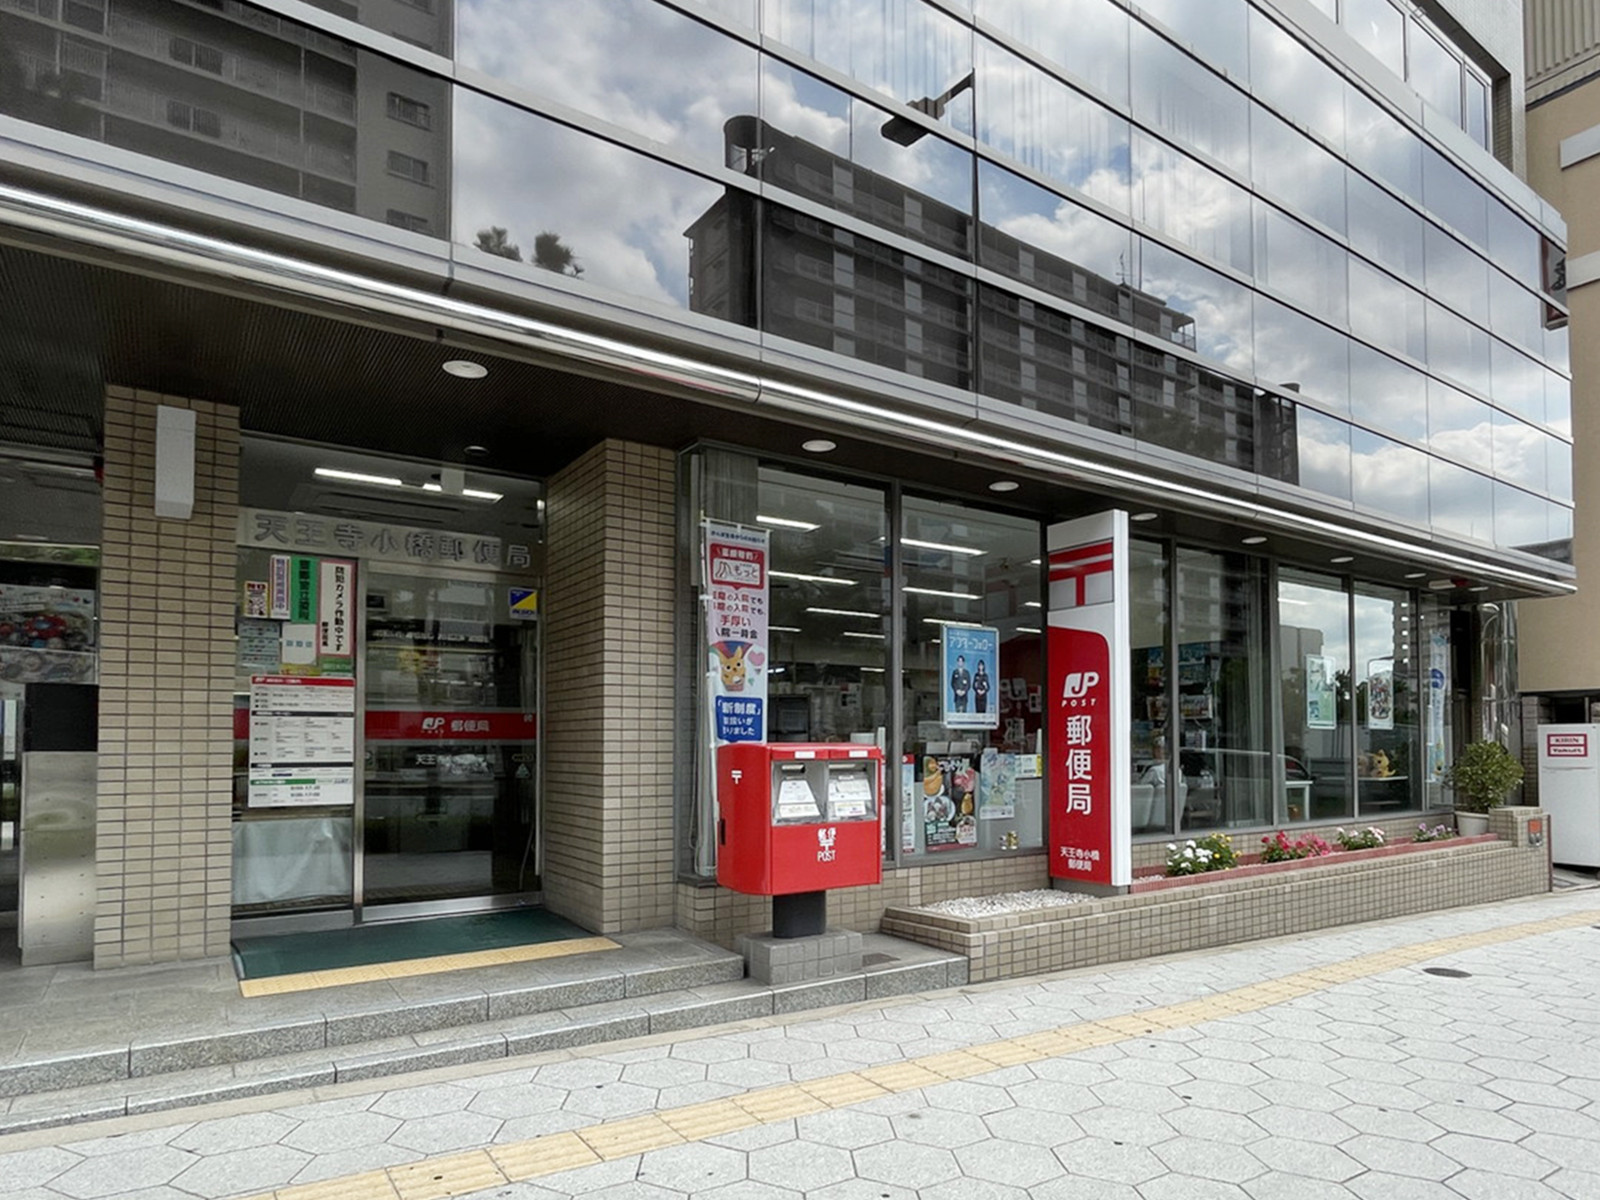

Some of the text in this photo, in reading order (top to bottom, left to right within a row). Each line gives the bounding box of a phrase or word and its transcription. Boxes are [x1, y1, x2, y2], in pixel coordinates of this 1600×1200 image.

[720, 614, 752, 627] 手厚い
[1061, 699, 1097, 708] POST
[451, 719, 491, 732] 郵便局
[1065, 715, 1093, 815] 郵便局
[816, 850, 836, 862] POST
[1068, 858, 1092, 871] 郵便局
